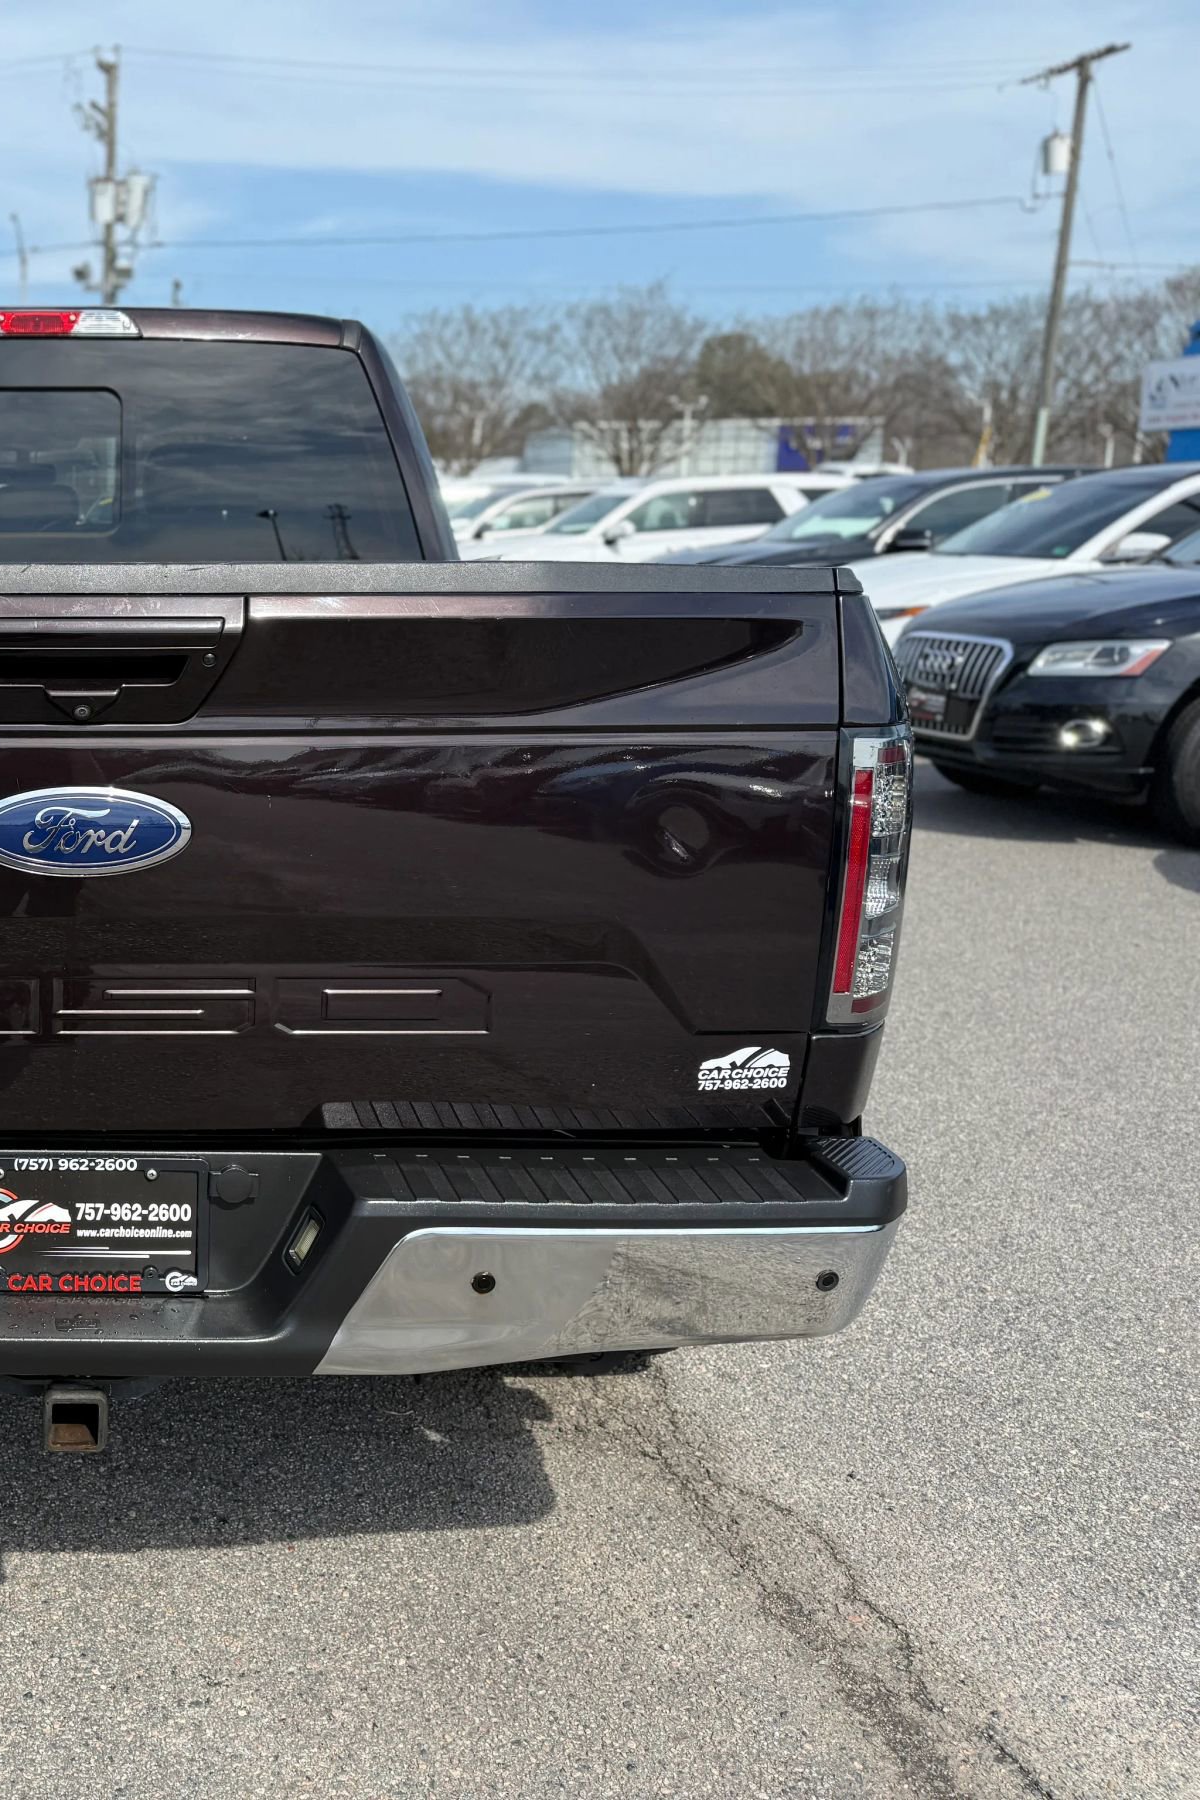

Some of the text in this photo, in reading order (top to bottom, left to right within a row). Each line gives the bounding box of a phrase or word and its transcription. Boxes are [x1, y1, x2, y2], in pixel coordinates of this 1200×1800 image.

[22, 806, 141, 854] Ford
[697, 1078, 787, 1091] 757-962-2600
[13, 1158, 138, 1172] (757) 962-2600
[75, 1203, 192, 1222] 757-962-2600
[13, 1222, 71, 1234] CHOICE
[76, 1227, 193, 1239] www.carchoiceonline.com
[8, 1275, 142, 1292] CAR CHOICE
